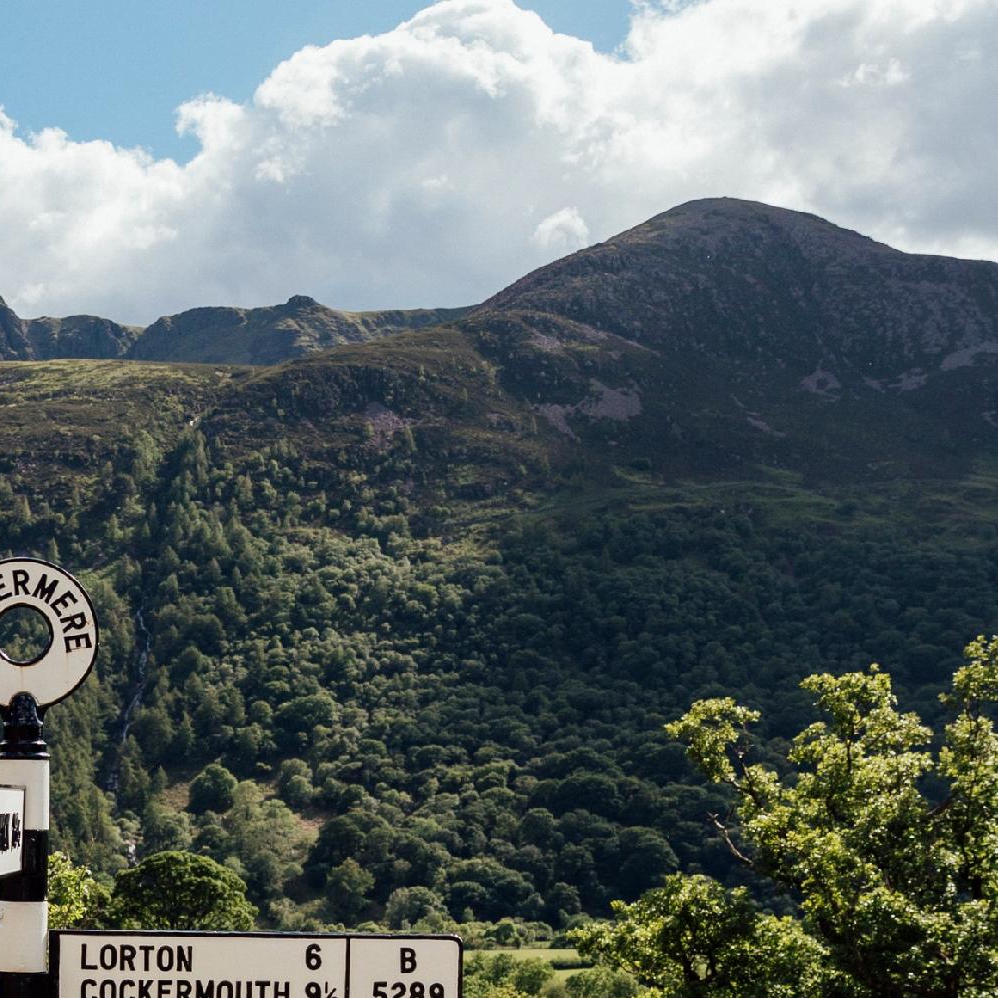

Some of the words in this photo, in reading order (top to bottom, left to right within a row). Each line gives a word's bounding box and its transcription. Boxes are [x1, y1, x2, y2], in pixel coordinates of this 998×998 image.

[80, 943, 193, 973] LORTON
[305, 943, 322, 971] 6
[399, 947, 417, 974] B
